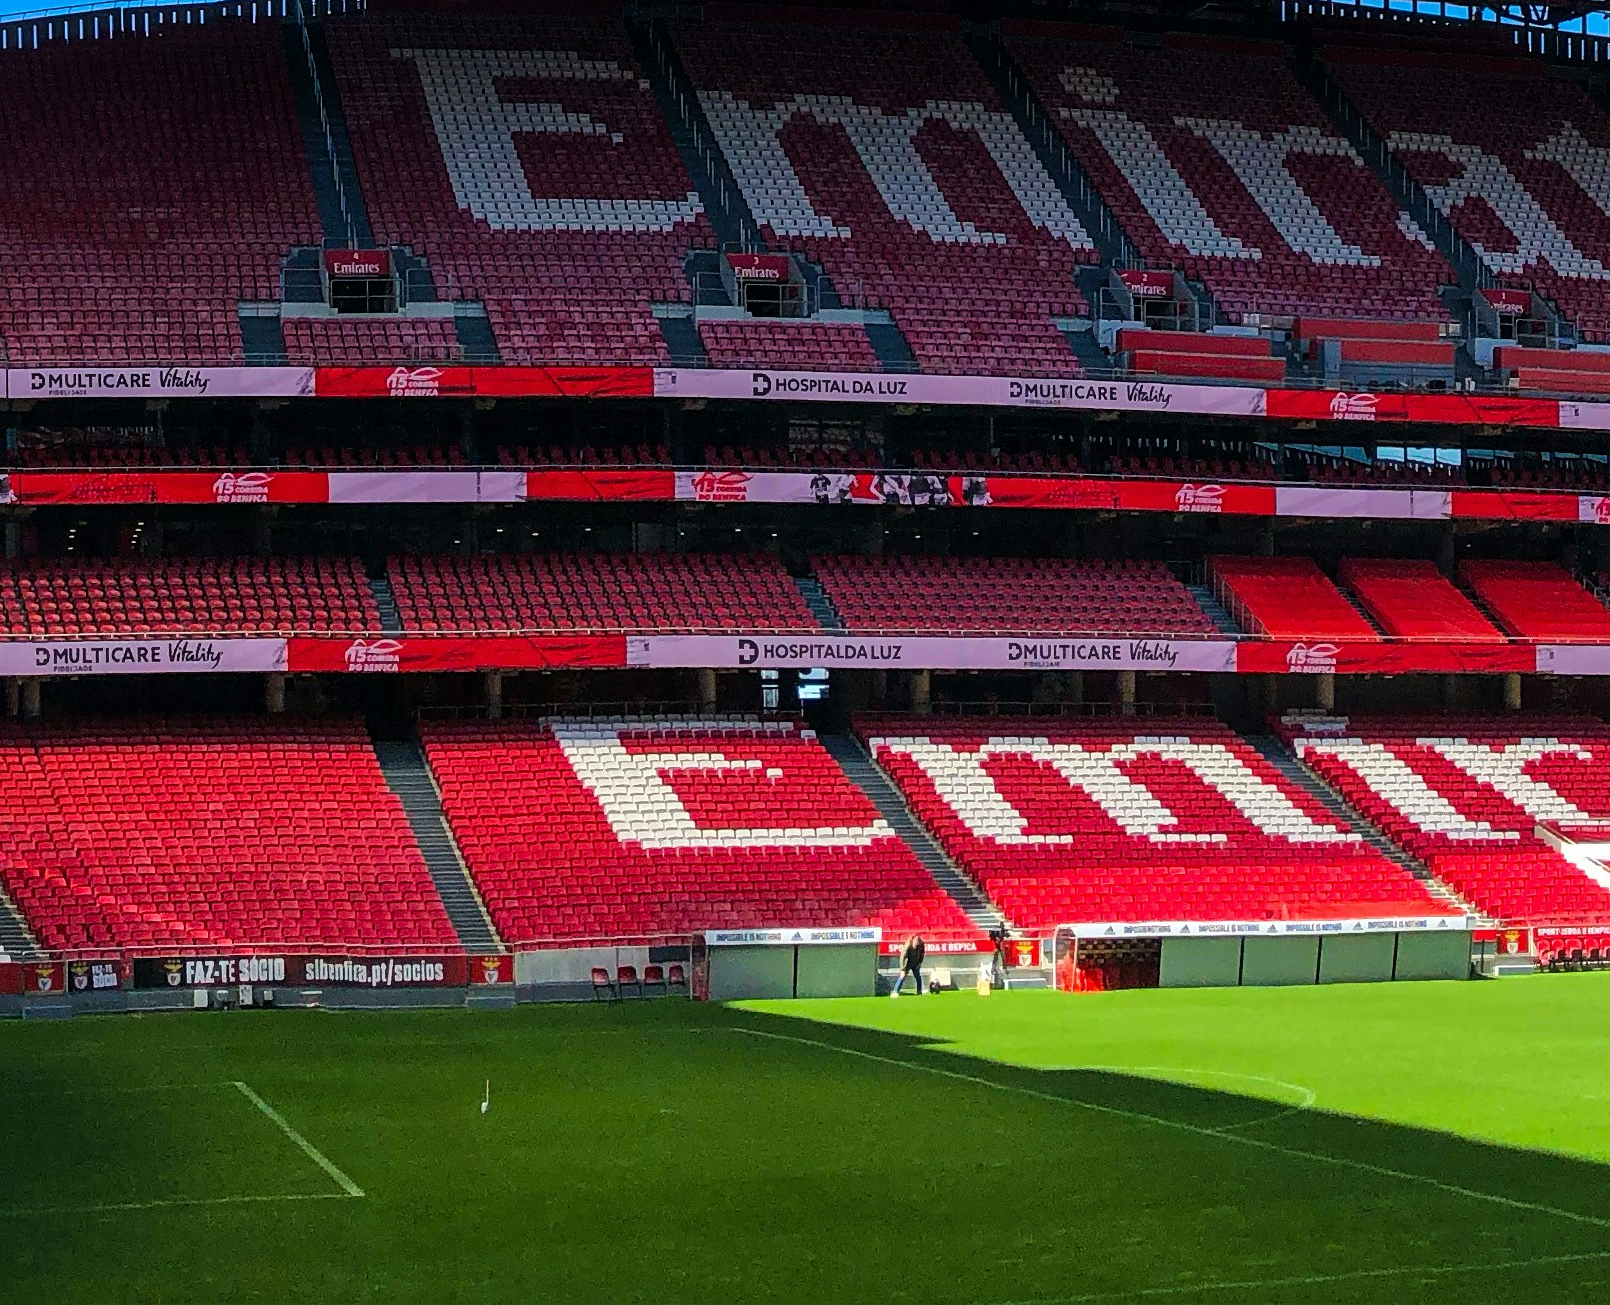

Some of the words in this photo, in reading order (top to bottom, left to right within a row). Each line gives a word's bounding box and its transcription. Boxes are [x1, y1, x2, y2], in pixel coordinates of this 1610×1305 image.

[353, 252, 359, 260] 4
[753, 256, 760, 265] 3
[334, 262, 380, 274] Emirates
[734, 267, 780, 279] Emirates
[49, 373, 150, 388] MULTICARE
[159, 368, 210, 393] Vitality
[775, 378, 850, 393] HOSPITAL
[852, 380, 874, 393] DA
[878, 381, 908, 395] LUZ
[1024, 383, 1118, 401] MULTICARE
[1126, 383, 1173, 408] Vitality
[53, 647, 161, 663] MULTICARE
[169, 641, 223, 669] Vitality
[764, 644, 844, 659] HOSPITAL
[845, 645, 868, 660] DA
[870, 645, 901, 660] LUZ
[1024, 645, 1121, 660] MULTICARE
[1130, 640, 1178, 667] Vitality
[186, 960, 235, 984] FAZ-TE
